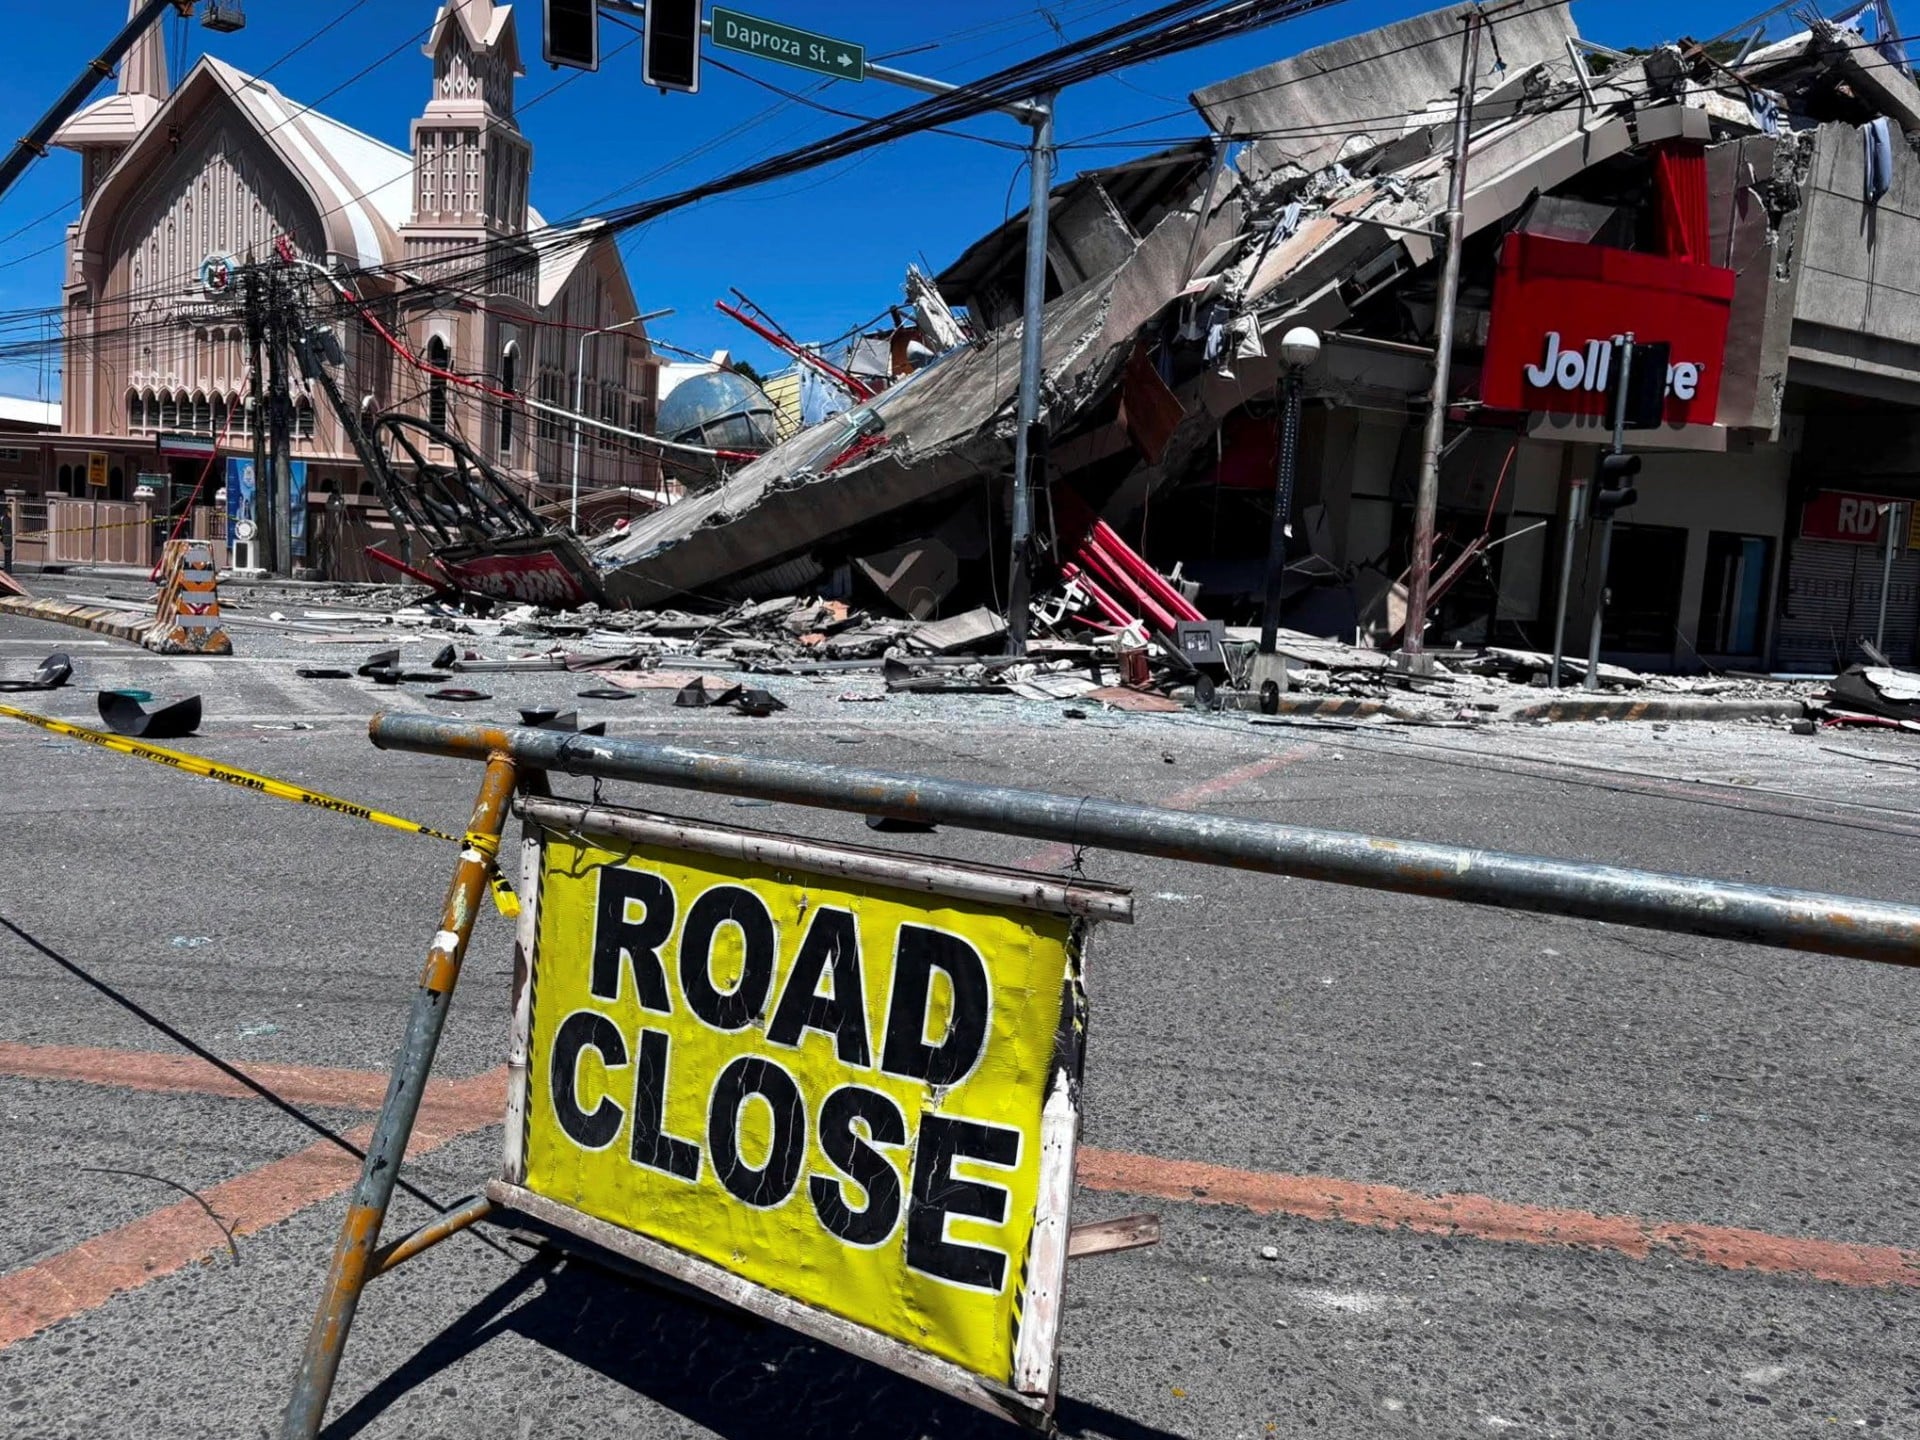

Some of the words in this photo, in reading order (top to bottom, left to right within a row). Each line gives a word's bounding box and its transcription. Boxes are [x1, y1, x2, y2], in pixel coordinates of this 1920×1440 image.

[726, 21, 800, 56] Daproza
[809, 43, 830, 64] St.
[1524, 331, 1699, 400] Jolle
[590, 865, 995, 1088] ROAD
[549, 1010, 1024, 1294] CLOSE
